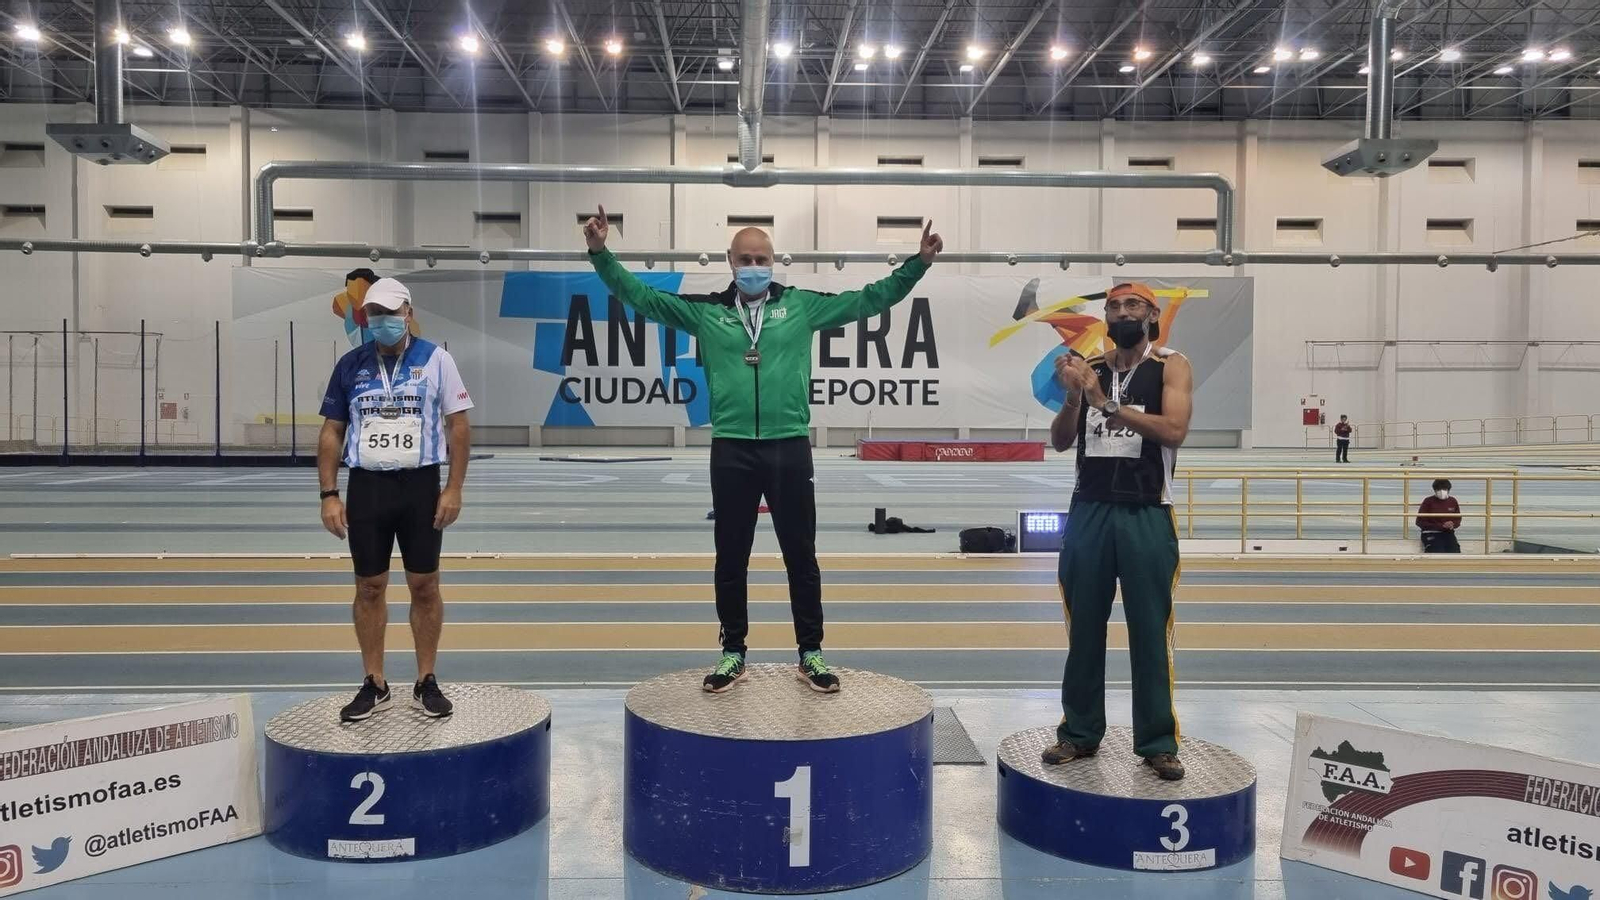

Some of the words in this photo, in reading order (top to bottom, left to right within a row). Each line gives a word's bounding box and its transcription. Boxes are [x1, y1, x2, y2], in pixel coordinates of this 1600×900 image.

[559, 377, 697, 405] CIUDAD
[808, 379, 939, 406] EPORTE
[359, 405, 422, 416] MÁGA
[368, 433, 413, 449] 5518
[83, 727, 151, 766] ANDALUZA
[155, 725, 172, 754] DE
[175, 712, 239, 748] ATLETISMO
[1322, 762, 1386, 790] F.A.A.
[0, 773, 182, 822] tletismofaa.es
[348, 771, 386, 825] 2
[774, 765, 811, 867] 1
[1159, 803, 1190, 852] 3
[1318, 813, 1329, 822] DE
[1330, 815, 1374, 832] ATLETISMO
[84, 804, 240, 858] @atletismoFAA
[330, 841, 405, 856] ANTEQUERA
[1136, 852, 1208, 869] ANTEQUERA
